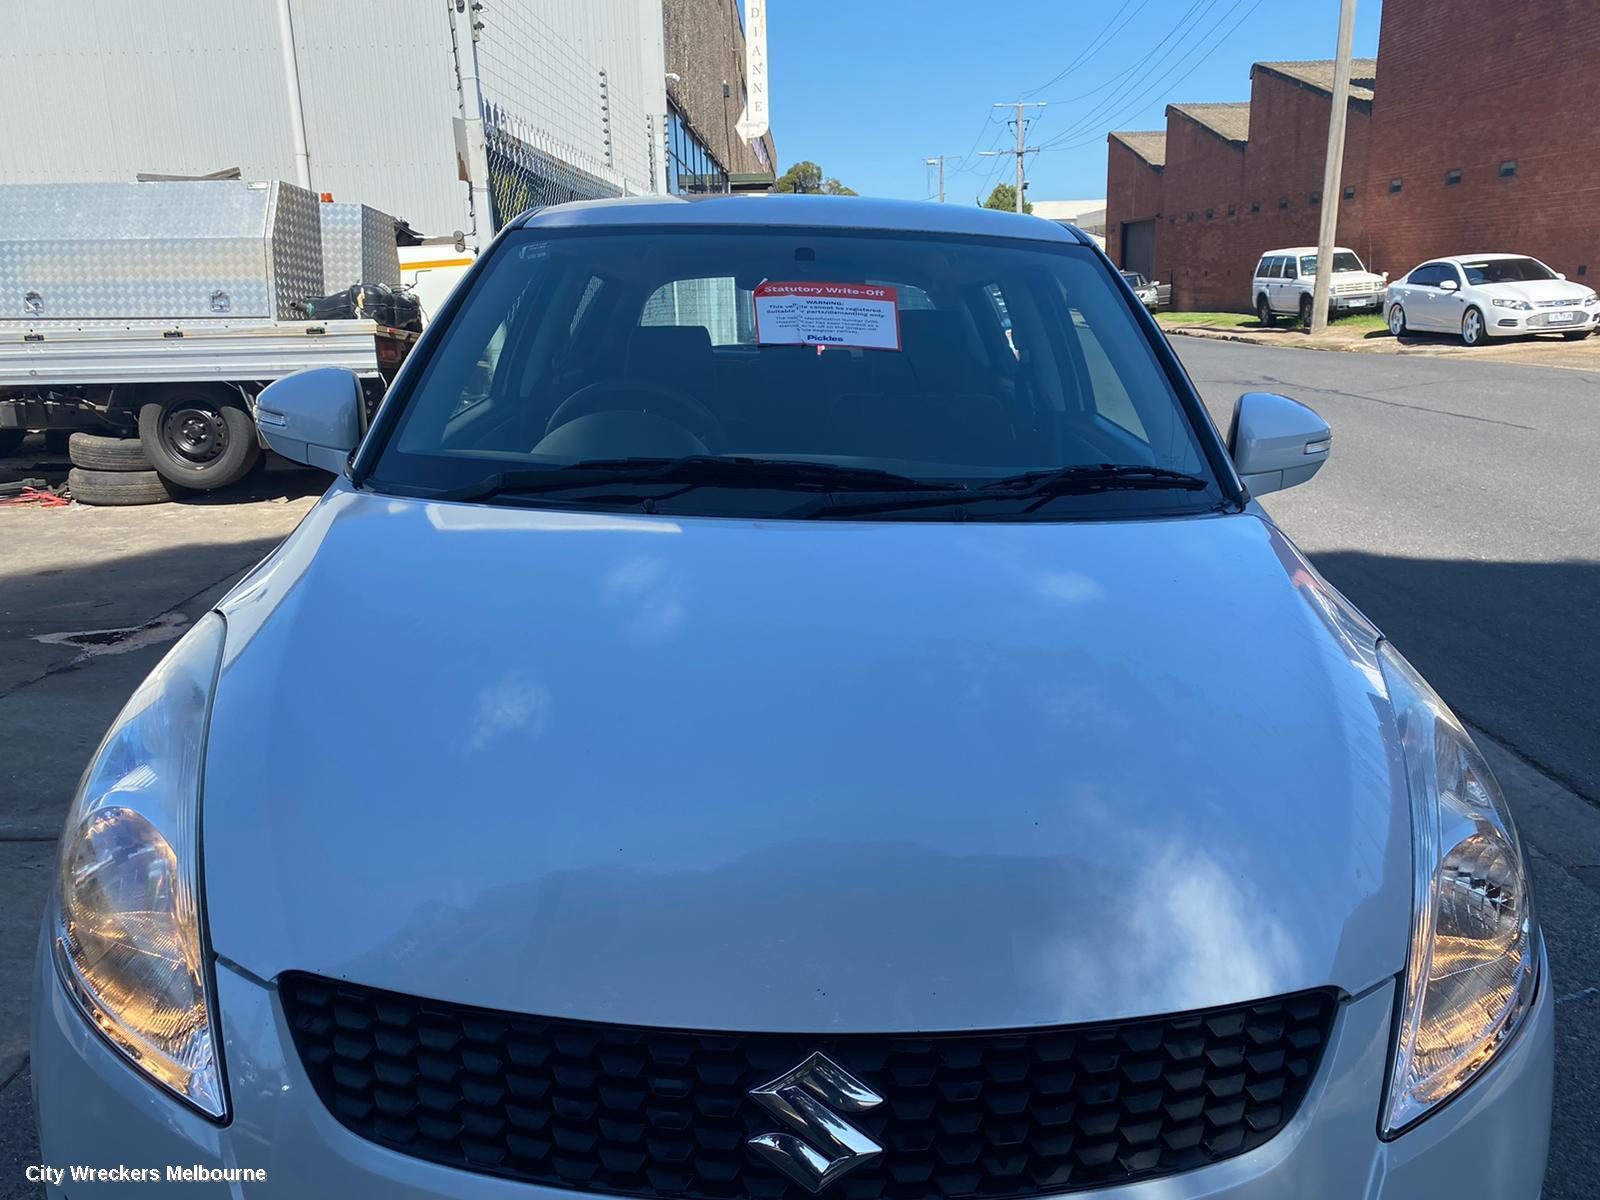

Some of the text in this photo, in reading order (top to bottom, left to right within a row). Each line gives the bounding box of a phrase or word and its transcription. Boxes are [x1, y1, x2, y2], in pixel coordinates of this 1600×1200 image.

[751, 8, 764, 112] DIANNE
[764, 286, 885, 297] Statutory Write-Off
[807, 334, 844, 342] Pickles
